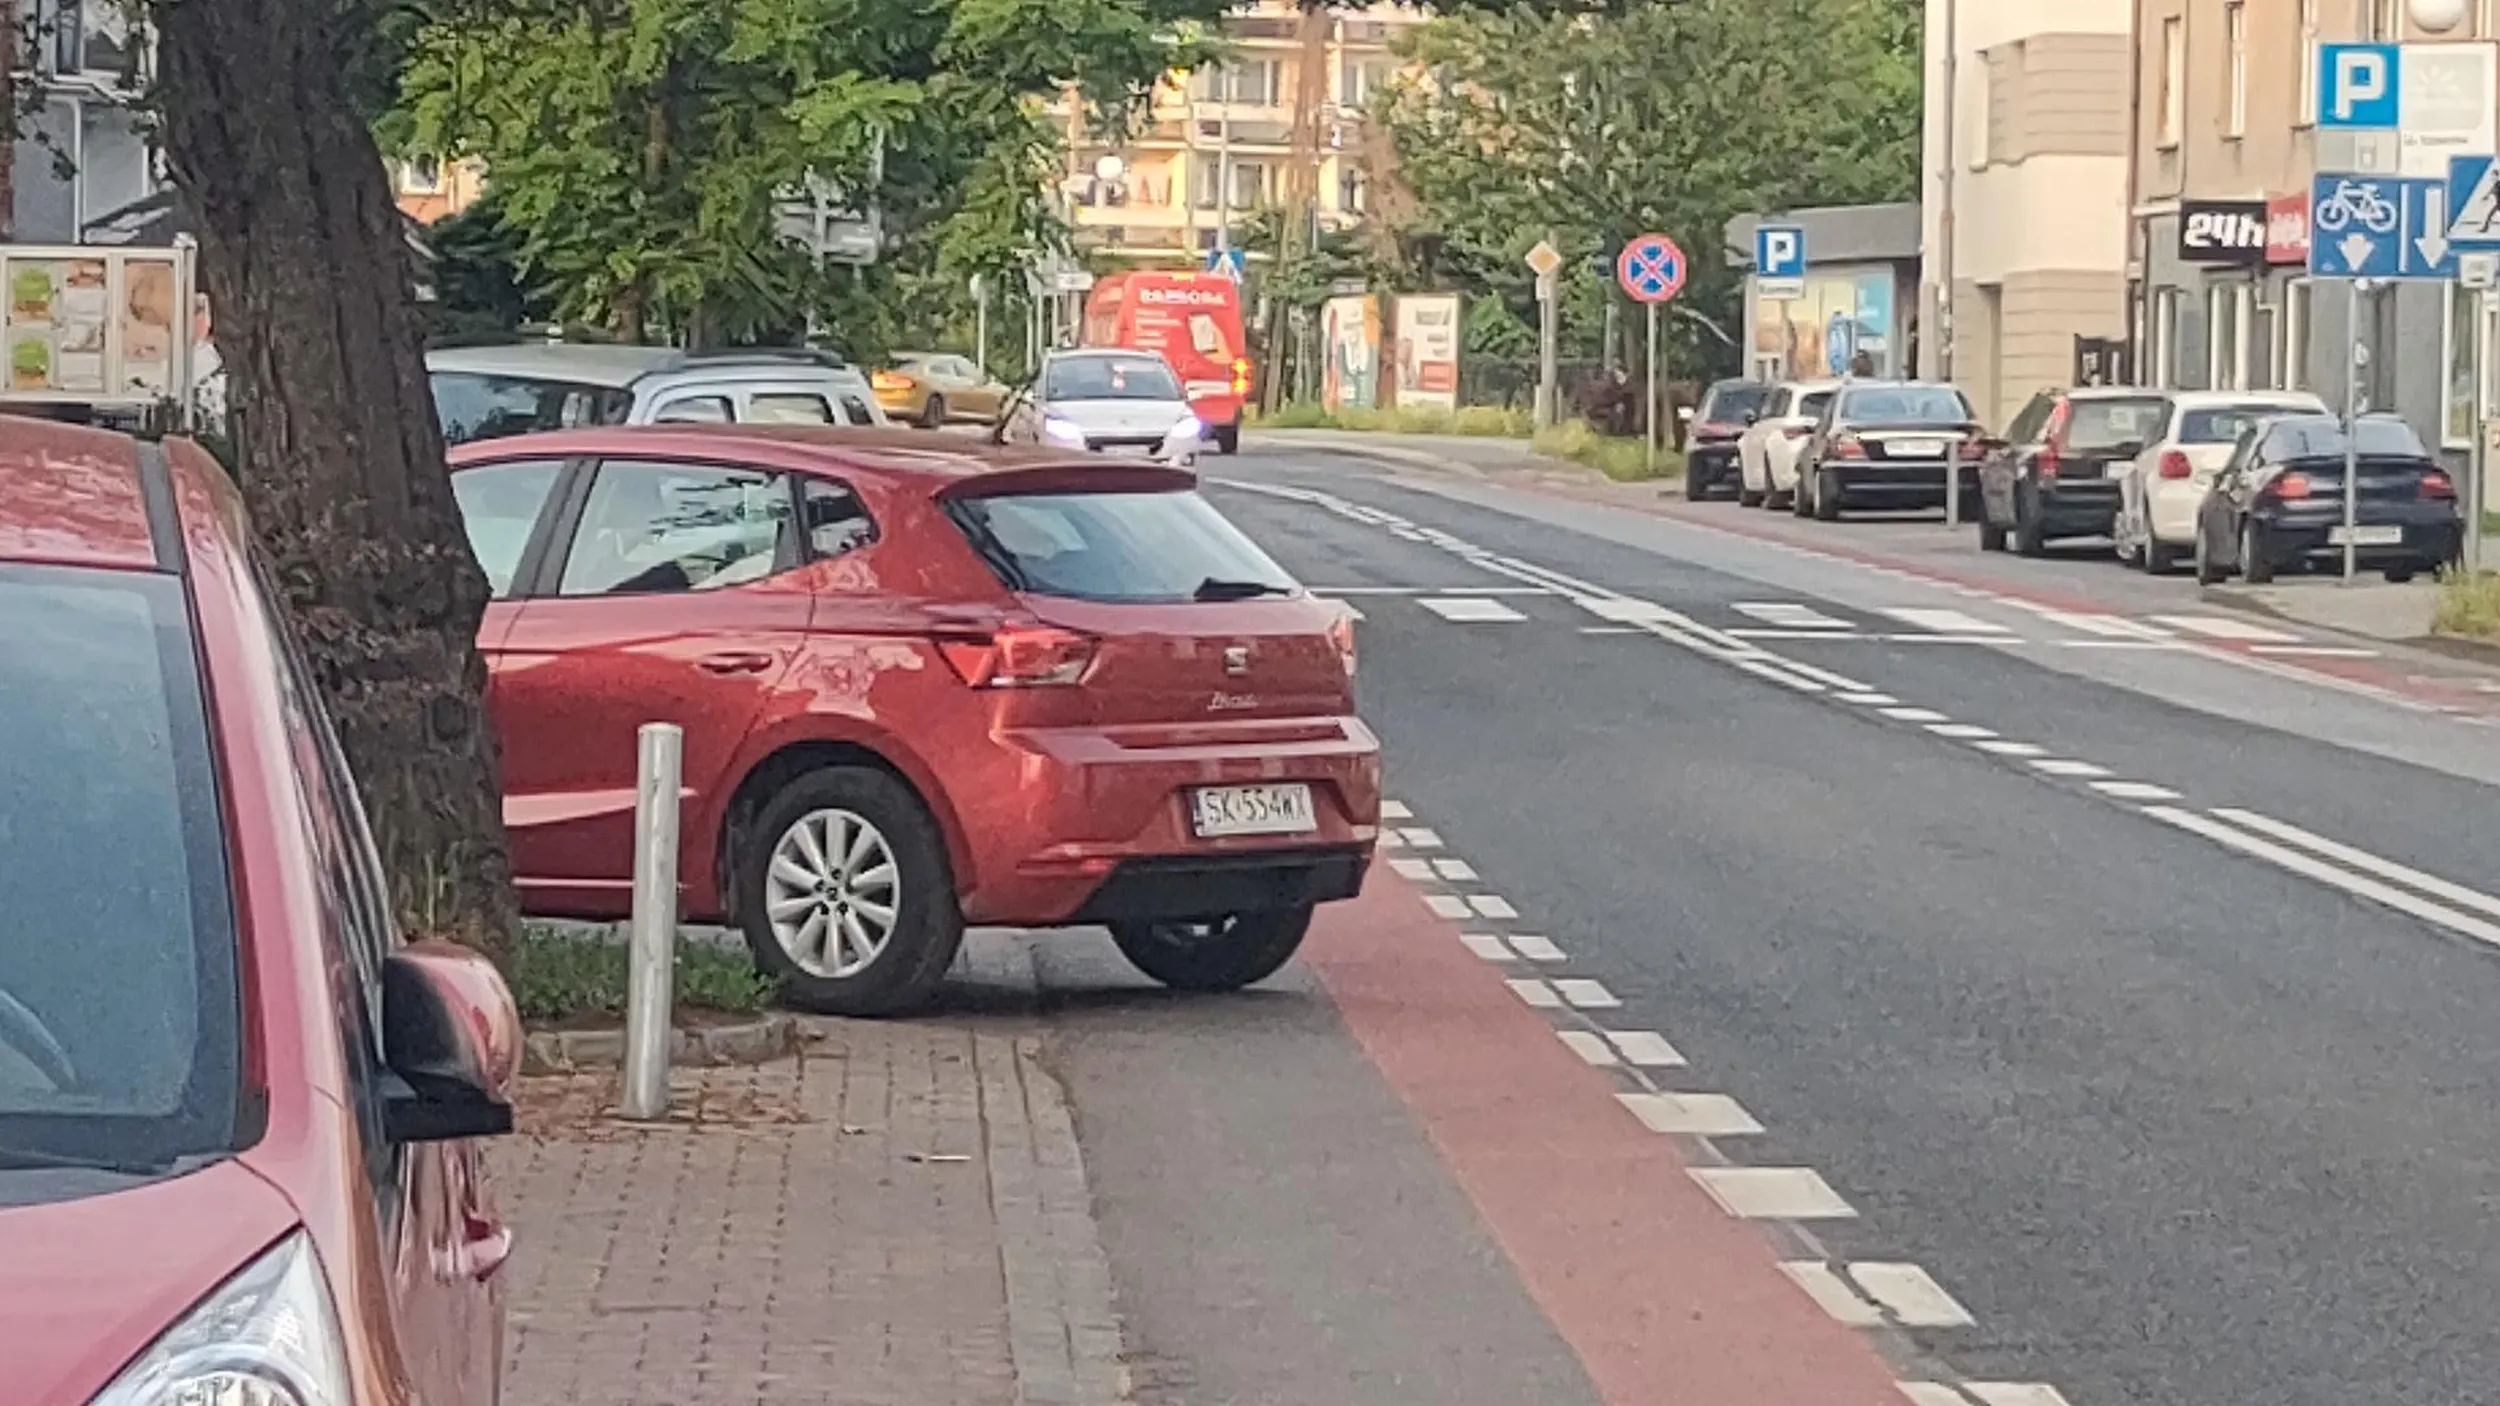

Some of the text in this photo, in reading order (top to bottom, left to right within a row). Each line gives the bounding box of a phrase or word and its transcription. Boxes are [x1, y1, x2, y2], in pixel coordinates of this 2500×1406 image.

[2335, 52, 2386, 119] P
[2184, 212, 2265, 247] 24h
[1766, 231, 1795, 272] P
[1206, 790, 1238, 823] SK
